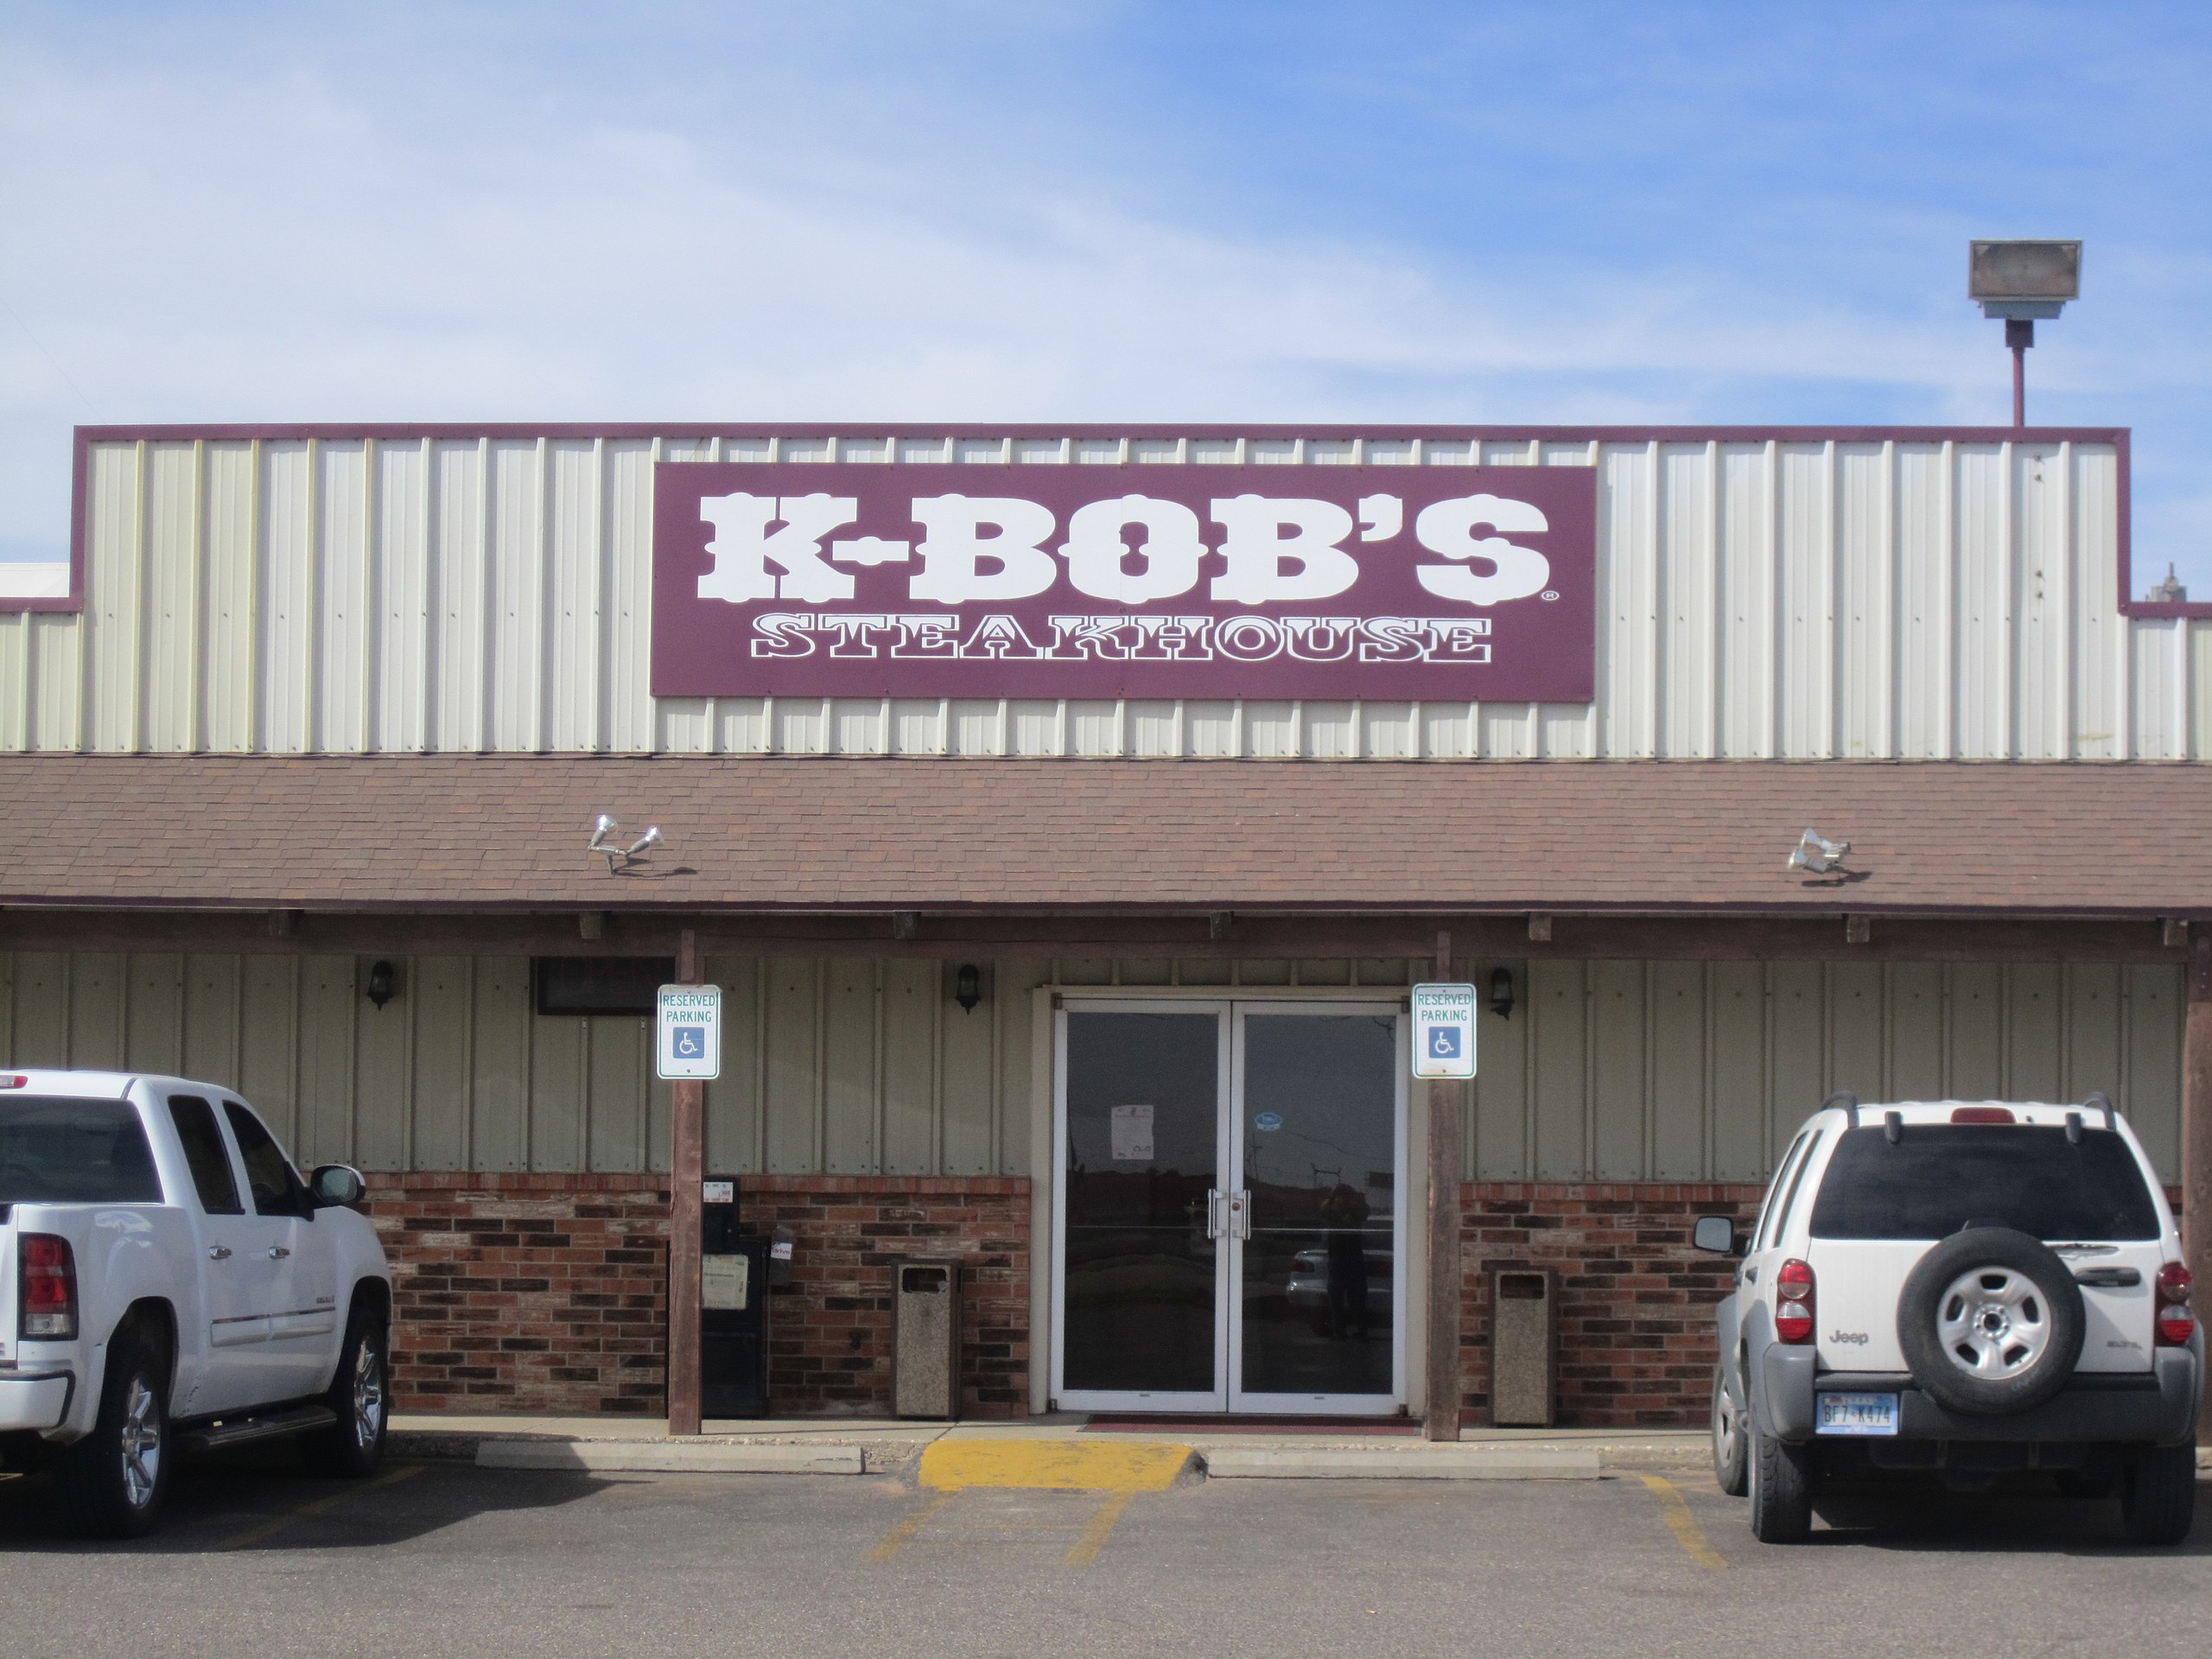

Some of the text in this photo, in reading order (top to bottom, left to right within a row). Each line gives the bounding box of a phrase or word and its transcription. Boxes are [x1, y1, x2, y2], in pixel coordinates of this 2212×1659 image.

[697, 492, 1550, 606] K-BOB'S
[750, 613, 1492, 664] STEAKHOUSE
[663, 995, 715, 1007] RESERVED
[1418, 994, 1471, 1006] RESERVED
[666, 1010, 712, 1022] PARKING
[1421, 1009, 1468, 1021] PARKING
[1829, 1329, 1870, 1346] Jeep
